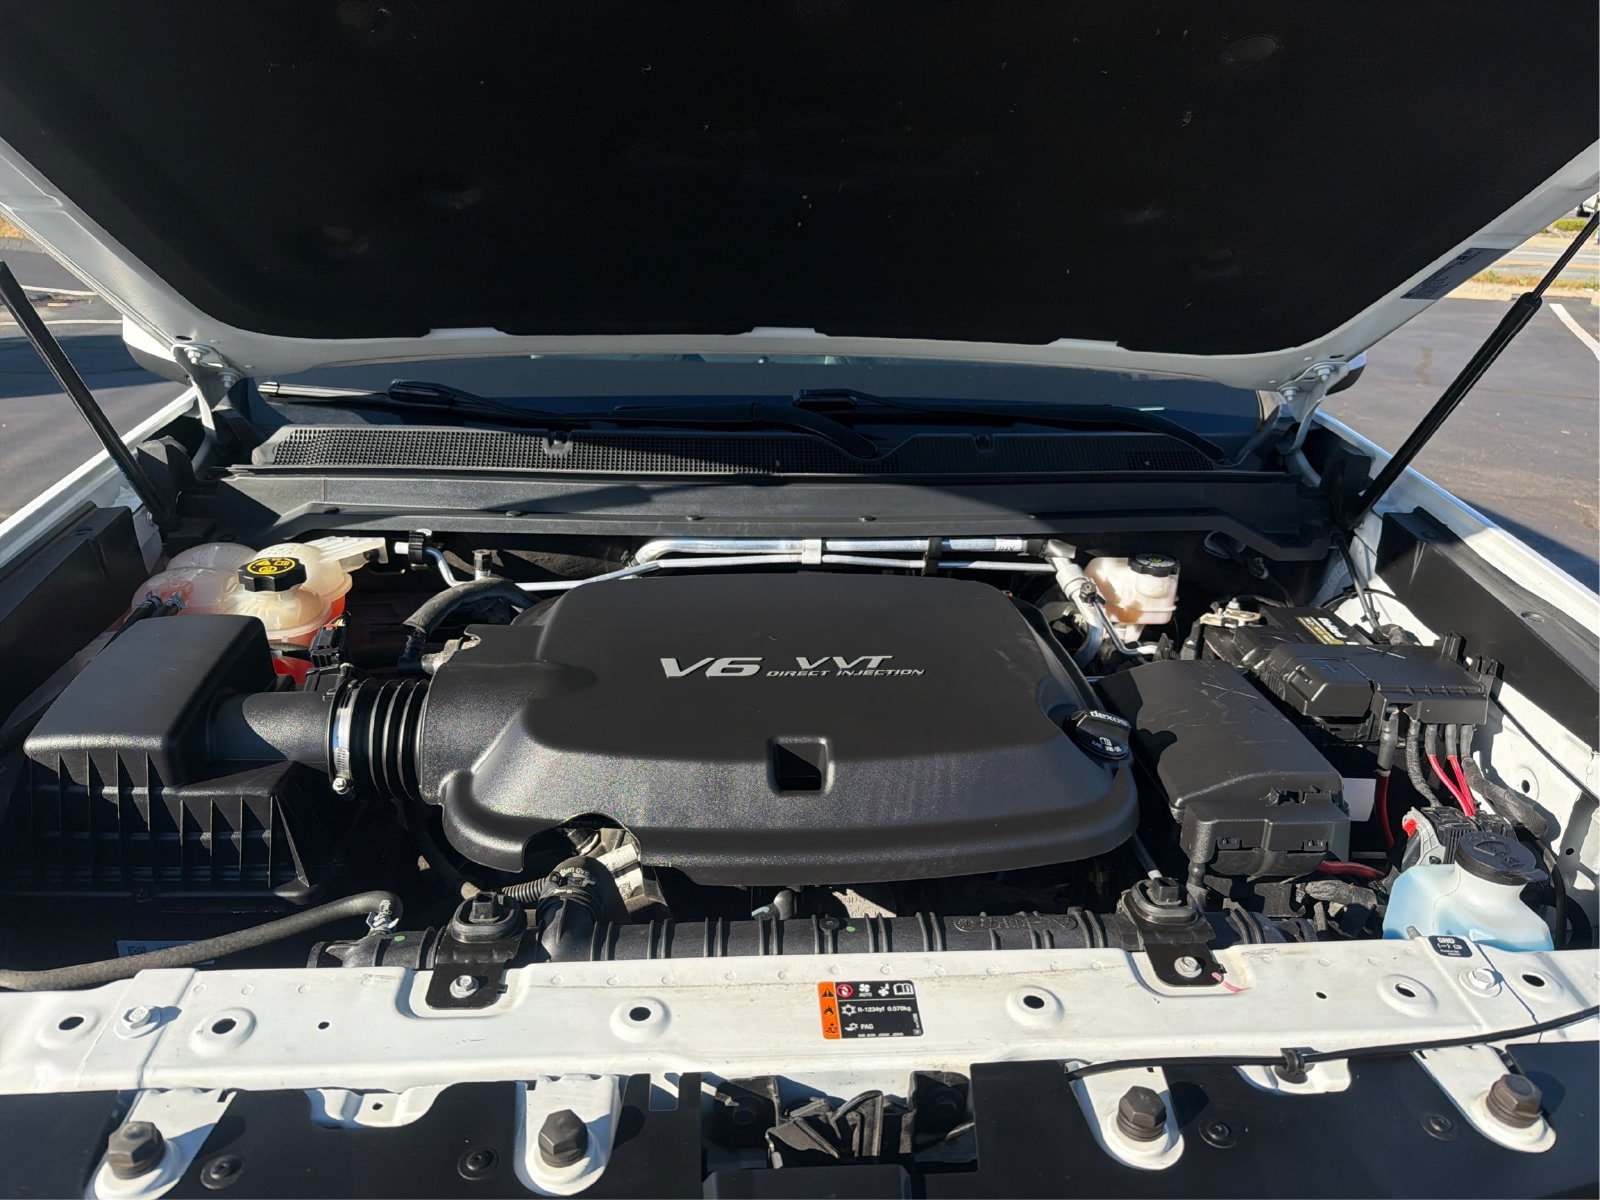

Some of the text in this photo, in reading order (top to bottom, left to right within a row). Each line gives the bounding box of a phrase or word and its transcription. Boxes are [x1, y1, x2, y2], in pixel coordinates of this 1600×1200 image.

[660, 655, 894, 678] V6 VVT
[836, 669, 926, 677] INJECTION
[1090, 710, 1128, 726] dexos
